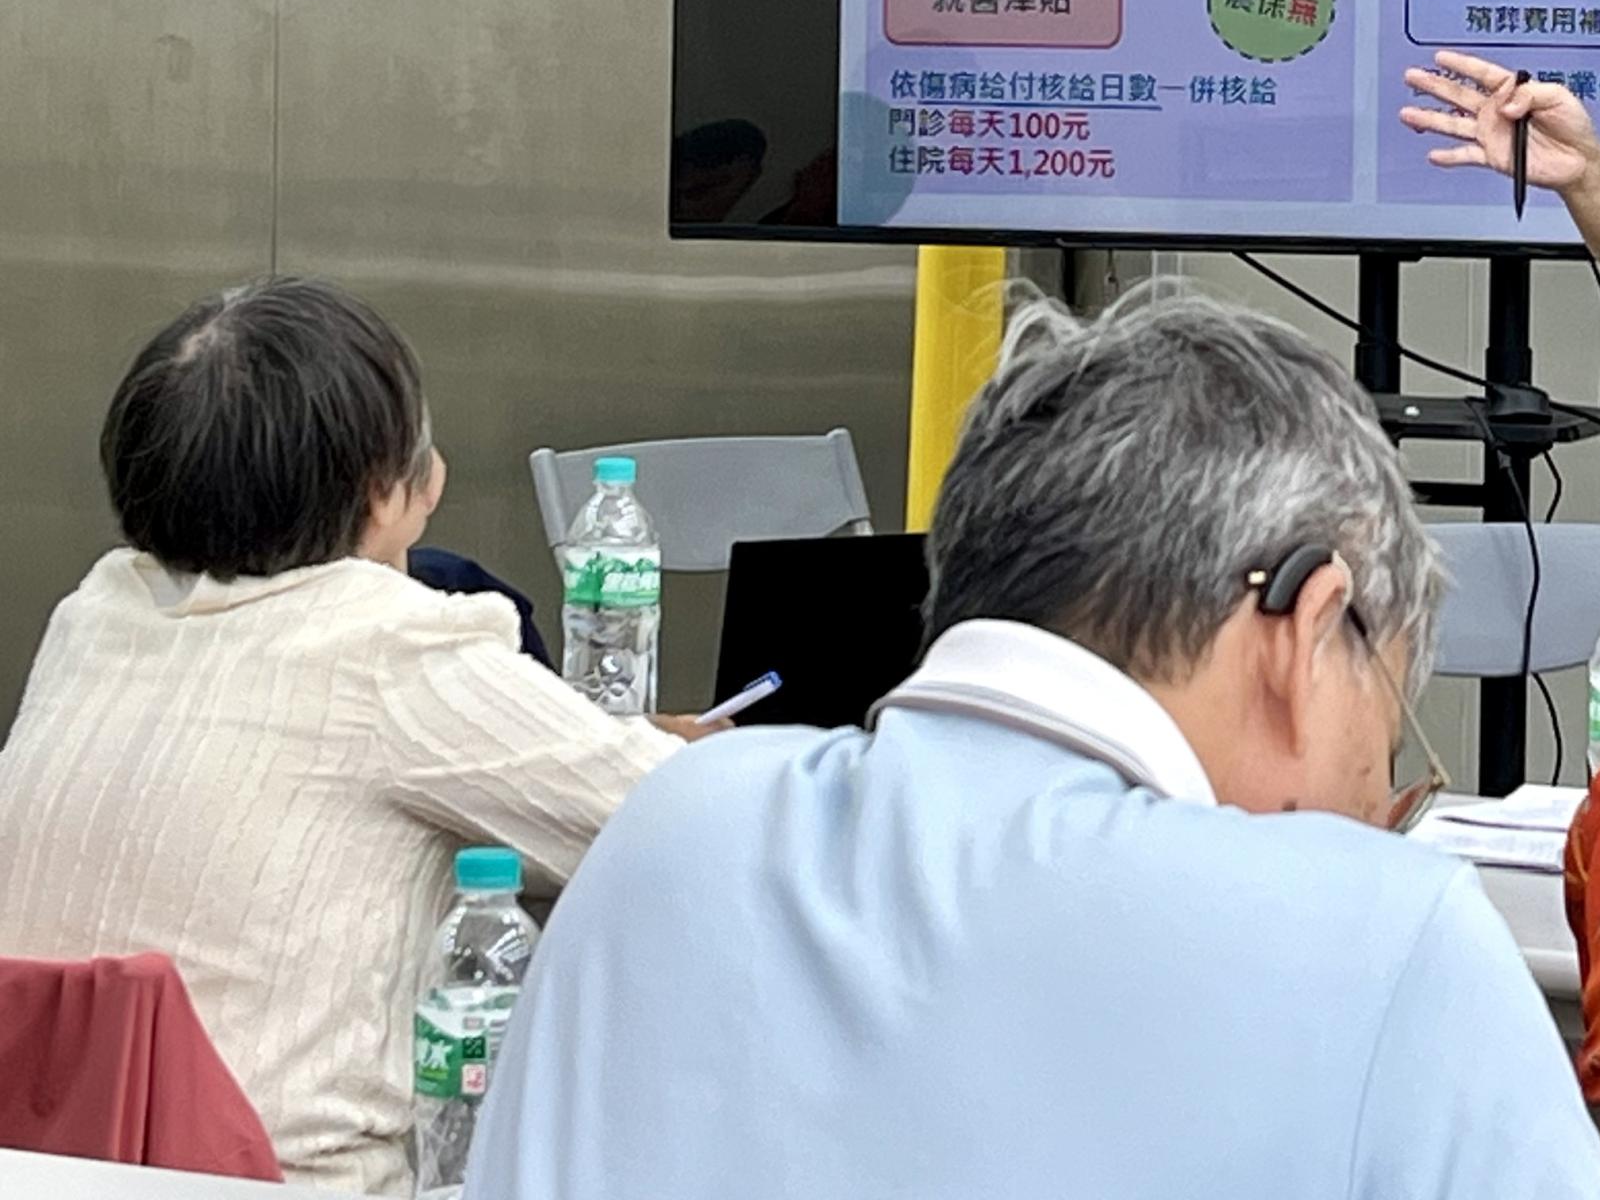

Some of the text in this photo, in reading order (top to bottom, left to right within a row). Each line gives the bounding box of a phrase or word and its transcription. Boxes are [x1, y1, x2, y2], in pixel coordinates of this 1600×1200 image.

[890, 69, 1278, 106] 依傷病給付核給日數一併核給
[888, 107, 1091, 141] 門診每天100元
[888, 144, 1116, 179] 住院每天1,200元
